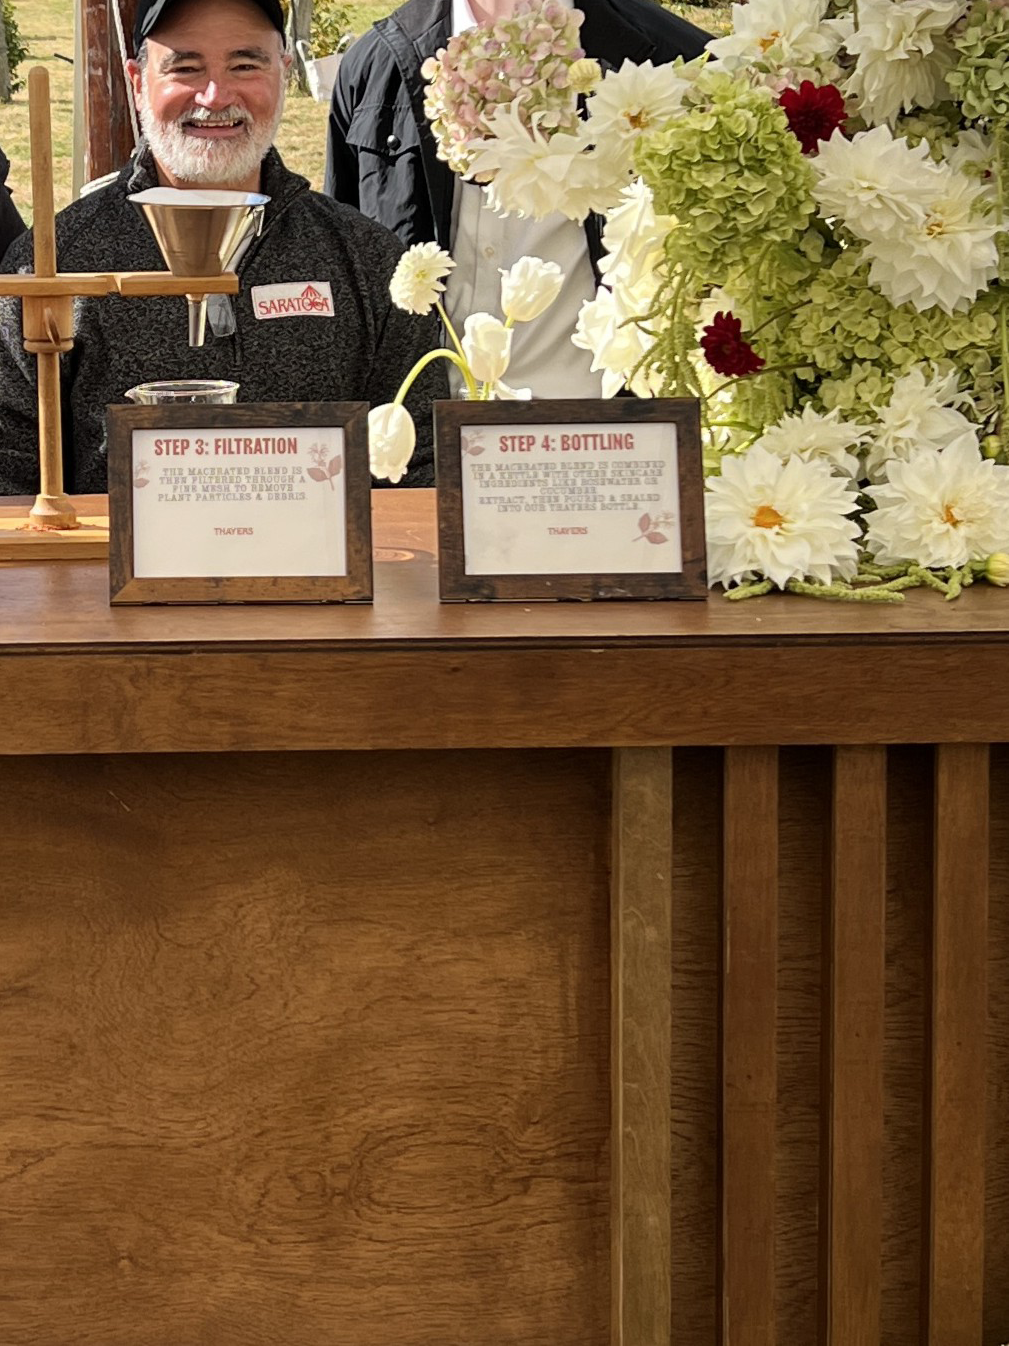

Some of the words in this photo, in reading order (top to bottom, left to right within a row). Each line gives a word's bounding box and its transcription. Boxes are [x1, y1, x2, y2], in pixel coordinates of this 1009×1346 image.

[258, 297, 330, 315] SARATOGA
[154, 439, 189, 456] STEP
[195, 439, 209, 455] 3:
[215, 438, 297, 455] FILTRATION
[499, 436, 535, 452] STEP
[541, 435, 555, 451] 4:
[561, 433, 634, 451] BOTTLING
[163, 468, 183, 476] THE
[188, 467, 249, 476] MACERATED
[159, 477, 187, 485] THEN
